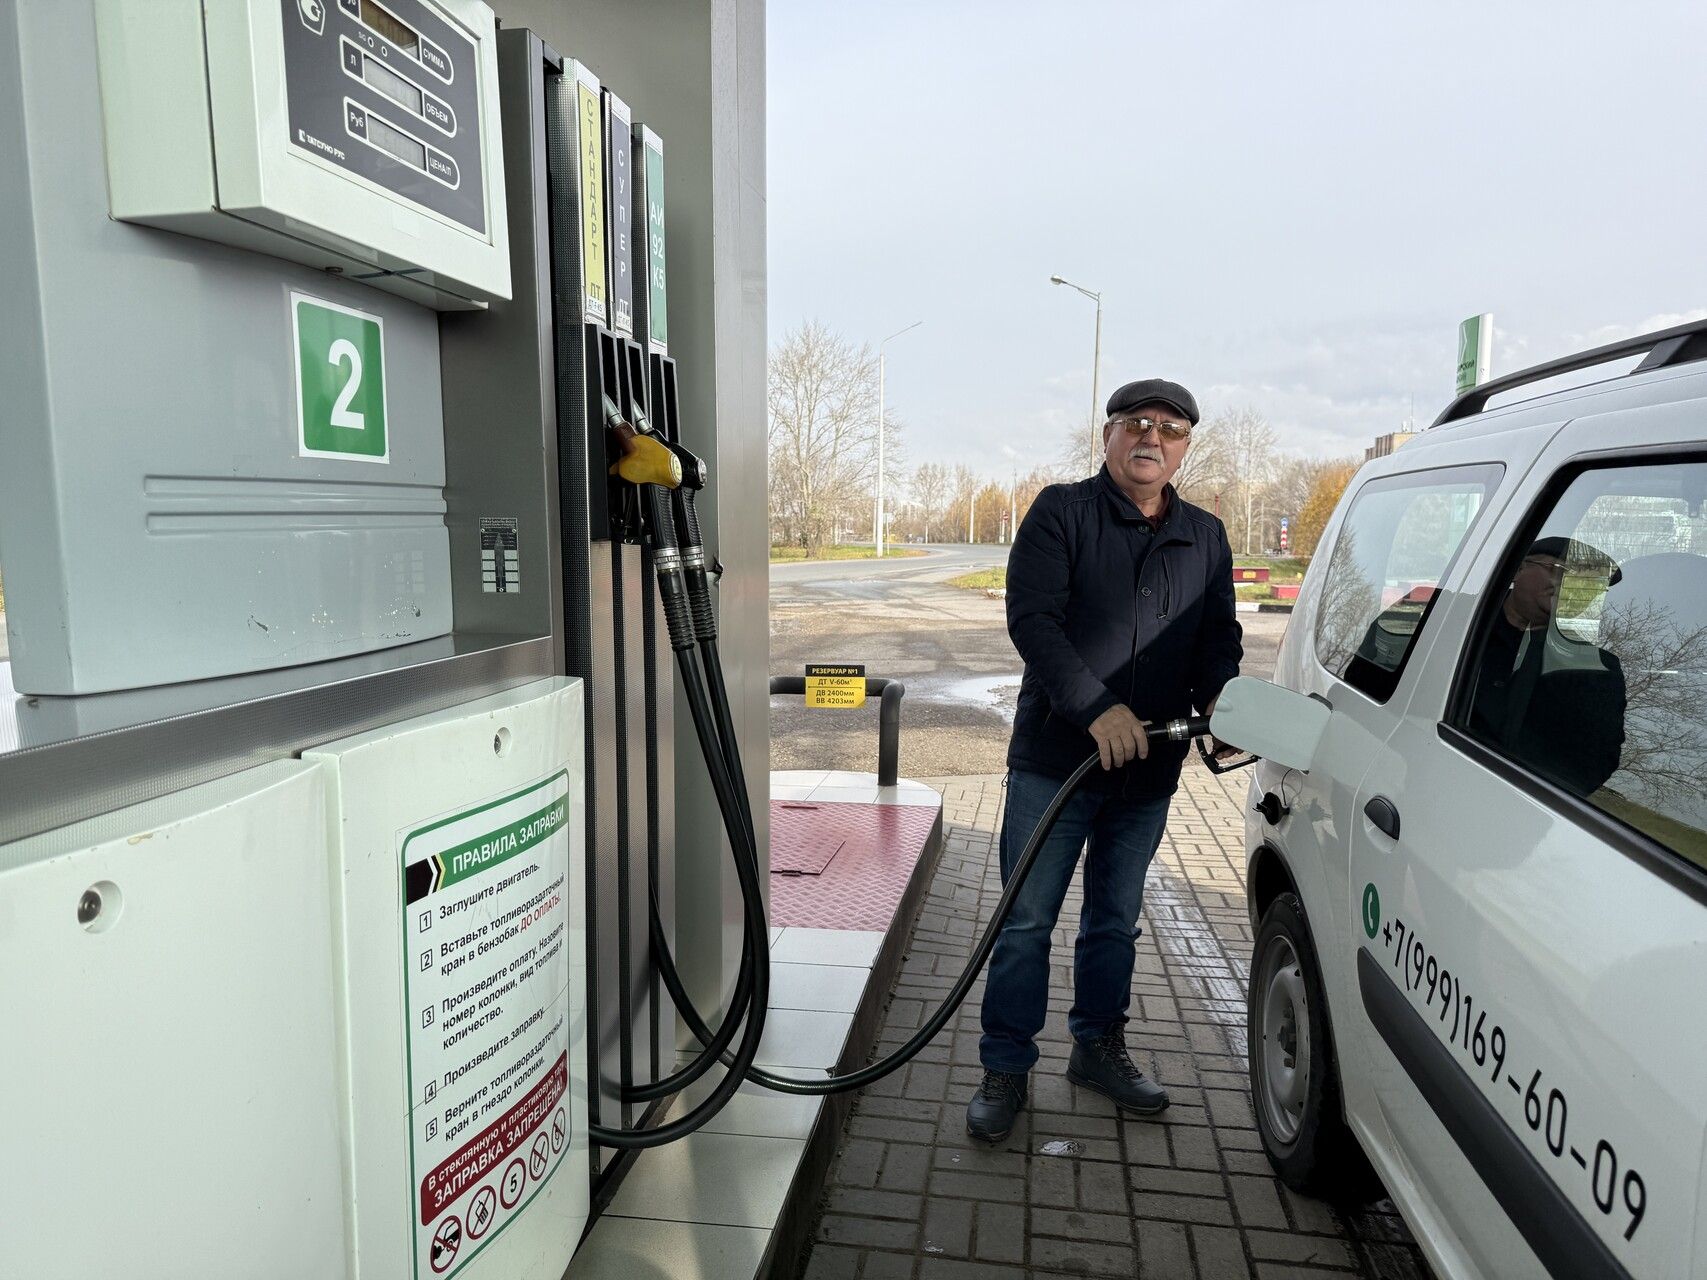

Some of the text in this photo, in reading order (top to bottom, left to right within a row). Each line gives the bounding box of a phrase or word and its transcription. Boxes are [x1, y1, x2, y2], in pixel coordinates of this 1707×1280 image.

[351, 54, 356, 66] Л
[423, 48, 446, 70] СУММА
[350, 112, 364, 128] Руб
[426, 102, 448, 124] ОБЪЕМ
[306, 134, 334, 154] ТАТСУНО
[586, 98, 598, 261] СТАНДАРТ
[650, 200, 665, 230] АИ
[652, 234, 664, 260] 92
[653, 264, 664, 290] К5
[328, 338, 365, 430] 2
[452, 804, 564, 874] ПРАВИЛА ЗАПРАВКИ
[439, 886, 494, 920] Заглушите
[440, 928, 488, 957] Вставьте
[490, 872, 564, 931] топливораздаточный
[441, 956, 466, 976] кран
[468, 950, 475, 961] в
[478, 924, 520, 956] бензобак
[520, 914, 532, 933] ДО
[442, 968, 508, 1013] Произведите
[509, 947, 538, 972] оплату.
[538, 922, 564, 951] Назовите
[442, 1004, 476, 1032] номер
[478, 979, 518, 1010] колонки,
[519, 967, 534, 983] вид
[535, 943, 559, 971] топлива
[443, 1007, 504, 1050] количество.
[444, 1036, 509, 1086] Произведите
[444, 1088, 488, 1123] Верните
[490, 1014, 563, 1090] топливораздаточный
[1383, 918, 1647, 1242] +7(999)169-60-09
[445, 1056, 544, 1142] кран в гнездо колонки.
[428, 1178, 436, 1190] В
[438, 1128, 498, 1182] стеклянную
[500, 1120, 507, 1132] и
[508, 1075, 554, 1125] пластиковую
[434, 1076, 563, 1208] ЗАПРАВКА ЗАПРЕЩЕНА!
[510, 1173, 518, 1193] 5
